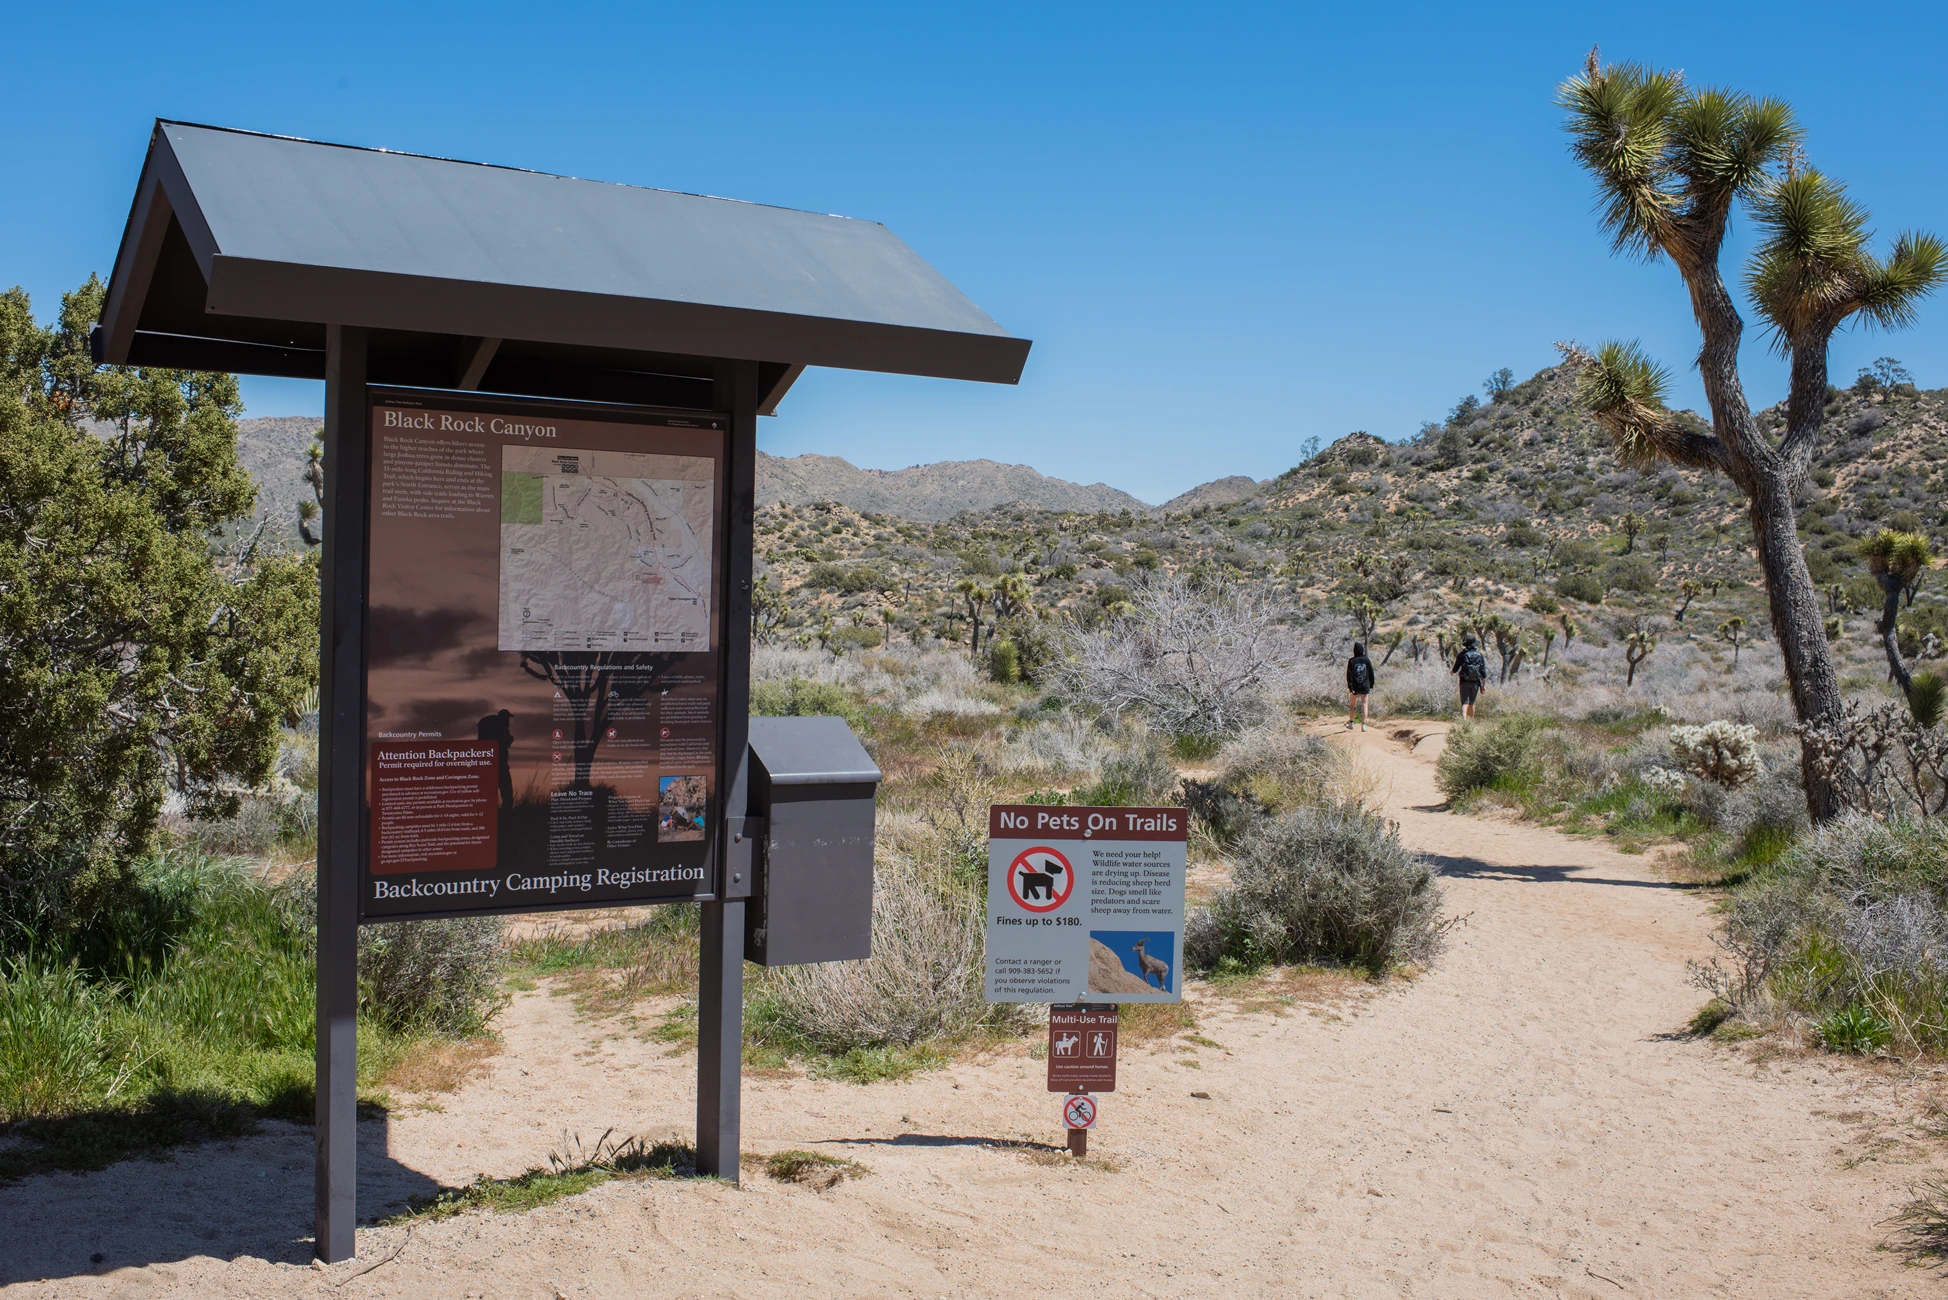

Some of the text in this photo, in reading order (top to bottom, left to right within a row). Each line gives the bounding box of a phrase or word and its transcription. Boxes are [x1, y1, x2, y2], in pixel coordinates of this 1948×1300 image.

[384, 411, 556, 439] Black Rock Canyon
[378, 749, 494, 760] Attention Backpackers!
[404, 760, 433, 770] required
[446, 759, 478, 768] overnight
[1000, 812, 1176, 832] No Pets On Trails
[1143, 851, 1161, 860] help!
[1105, 869, 1129, 878] drying
[374, 864, 704, 899] Backcountry Camping Registration
[1099, 878, 1131, 888] reducing
[1132, 879, 1153, 888] sheep
[1108, 888, 1127, 897] Dogs
[1091, 897, 1125, 906] predators
[1090, 906, 1112, 915] sheep
[997, 916, 1024, 925] Fines
[1025, 919, 1039, 928] up
[1055, 917, 1082, 927] $180.
[1018, 986, 1055, 995] regulation.
[1052, 1016, 1096, 1024] Multi-Use
